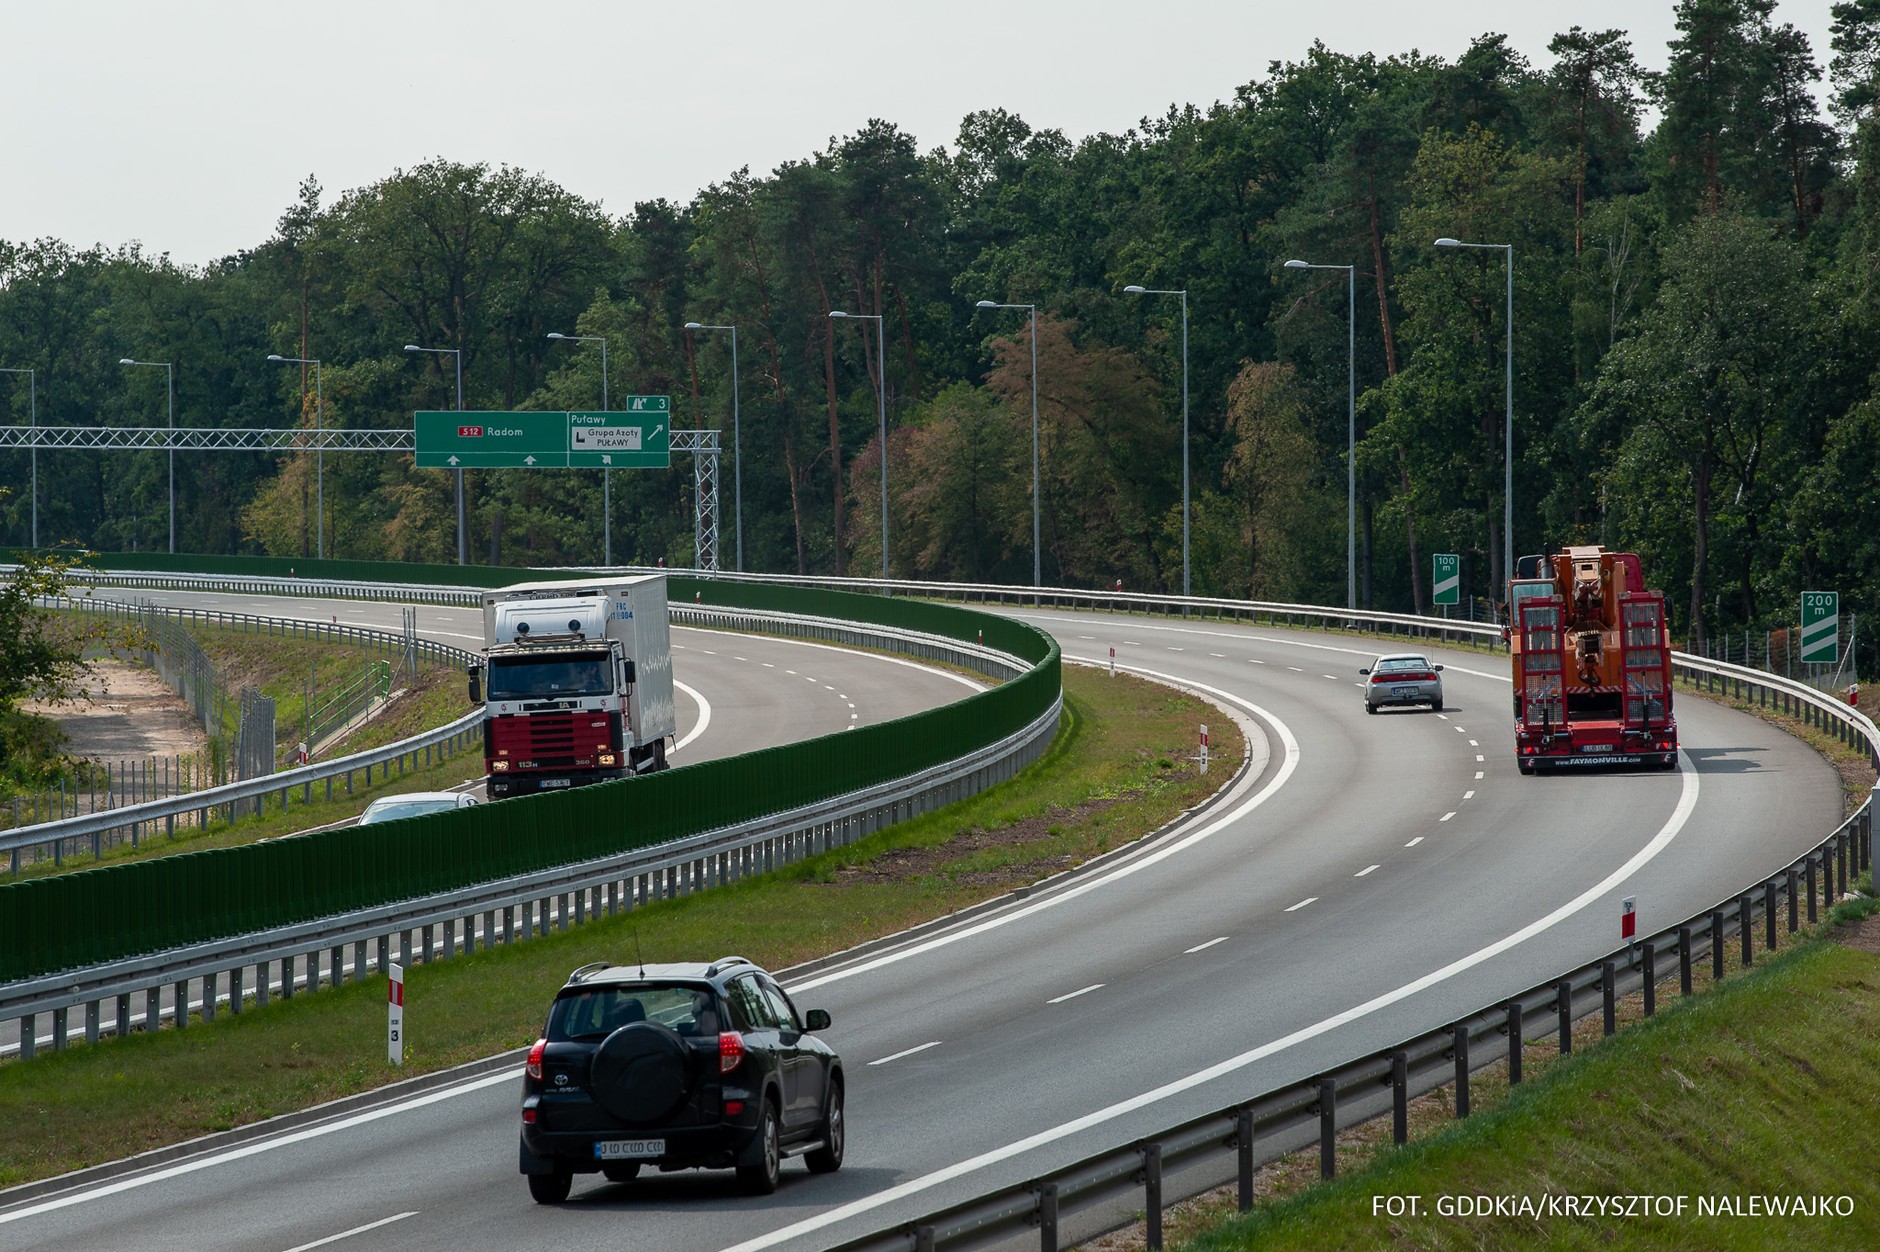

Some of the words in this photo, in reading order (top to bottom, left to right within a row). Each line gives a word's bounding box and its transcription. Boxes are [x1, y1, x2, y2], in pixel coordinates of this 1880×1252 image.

[658, 398, 666, 409] 3
[572, 414, 606, 426] Puławy
[488, 427, 522, 436] Radom
[588, 428, 614, 438] Grupa
[616, 429, 638, 438] Azoty
[1808, 596, 1832, 606] 200
[1814, 607, 1824, 615] m
[391, 1030, 399, 1042] 3
